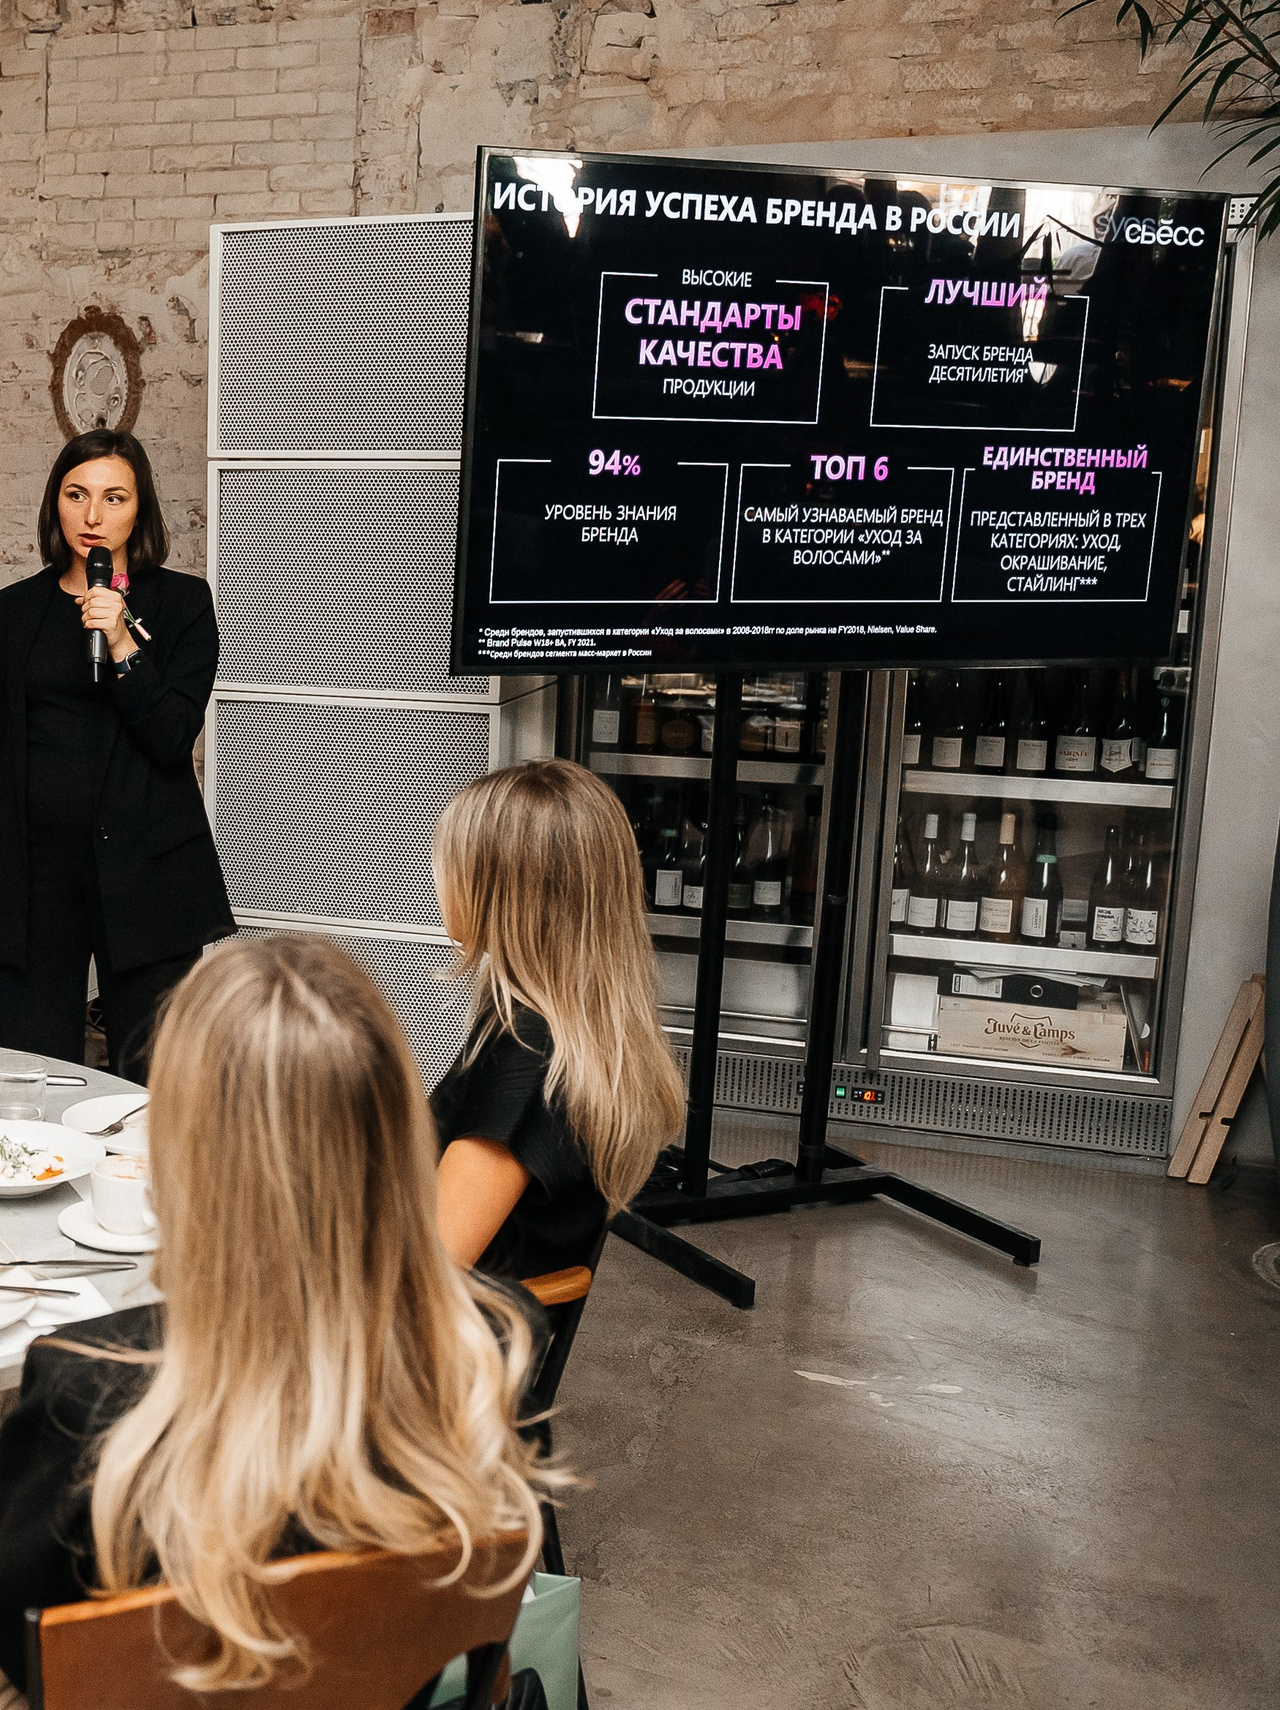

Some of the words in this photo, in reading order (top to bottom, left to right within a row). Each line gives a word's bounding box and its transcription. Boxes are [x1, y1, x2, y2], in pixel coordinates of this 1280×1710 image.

[646, 191, 757, 223] УСПЕХА
[765, 198, 876, 236] БРЕНДА
[886, 206, 901, 231] В
[910, 208, 1020, 238] РОССИИ
[682, 269, 752, 287] ВЫСОКИЕ
[924, 277, 1047, 307] ЛУЧШИЙ
[625, 298, 801, 333] СТАНДАРТЫ
[639, 336, 783, 369] КАЧЕСТВА
[928, 344, 980, 360] ЗАПУСК
[983, 346, 1034, 364] БРЕНДА
[663, 378, 755, 399] ПРОДУКЦИИ
[589, 449, 640, 475] 94%
[983, 444, 1147, 470] ЕДИНСТВЕННЫЙ
[811, 455, 865, 480] ТОП
[874, 456, 888, 481] 6
[1031, 471, 1095, 494] БРЕНД
[545, 505, 612, 520] УРОВЕНЬ
[616, 505, 676, 520] ЗНАНИЯ
[744, 504, 798, 522] САМЫЙ
[801, 506, 897, 524] УЗНАВАЕМЫЙ
[901, 509, 943, 527] БРЕНД
[971, 510, 1099, 529] ПРЕДСТАВЛЕННЫЙ
[1103, 513, 1111, 527] В
[1116, 513, 1146, 527] ТРЕХ
[582, 527, 638, 545] БРЕНДА
[763, 529, 770, 543] В
[775, 529, 854, 543] КАТЕГОРИИ
[858, 530, 902, 547] «УХОД
[905, 530, 922, 544] ЗА
[991, 533, 1078, 548] КАТЕГОРИЯХ:
[1082, 534, 1121, 552] УХОД,
[1001, 555, 1107, 572] ОКРАШИВАНИЕ,
[484, 628, 509, 639] Среди
[487, 639, 509, 647] Brand
[984, 1018, 1020, 1035] Juvé
[1022, 1026, 1031, 1036] &
[1034, 1023, 1075, 1042] Camps
